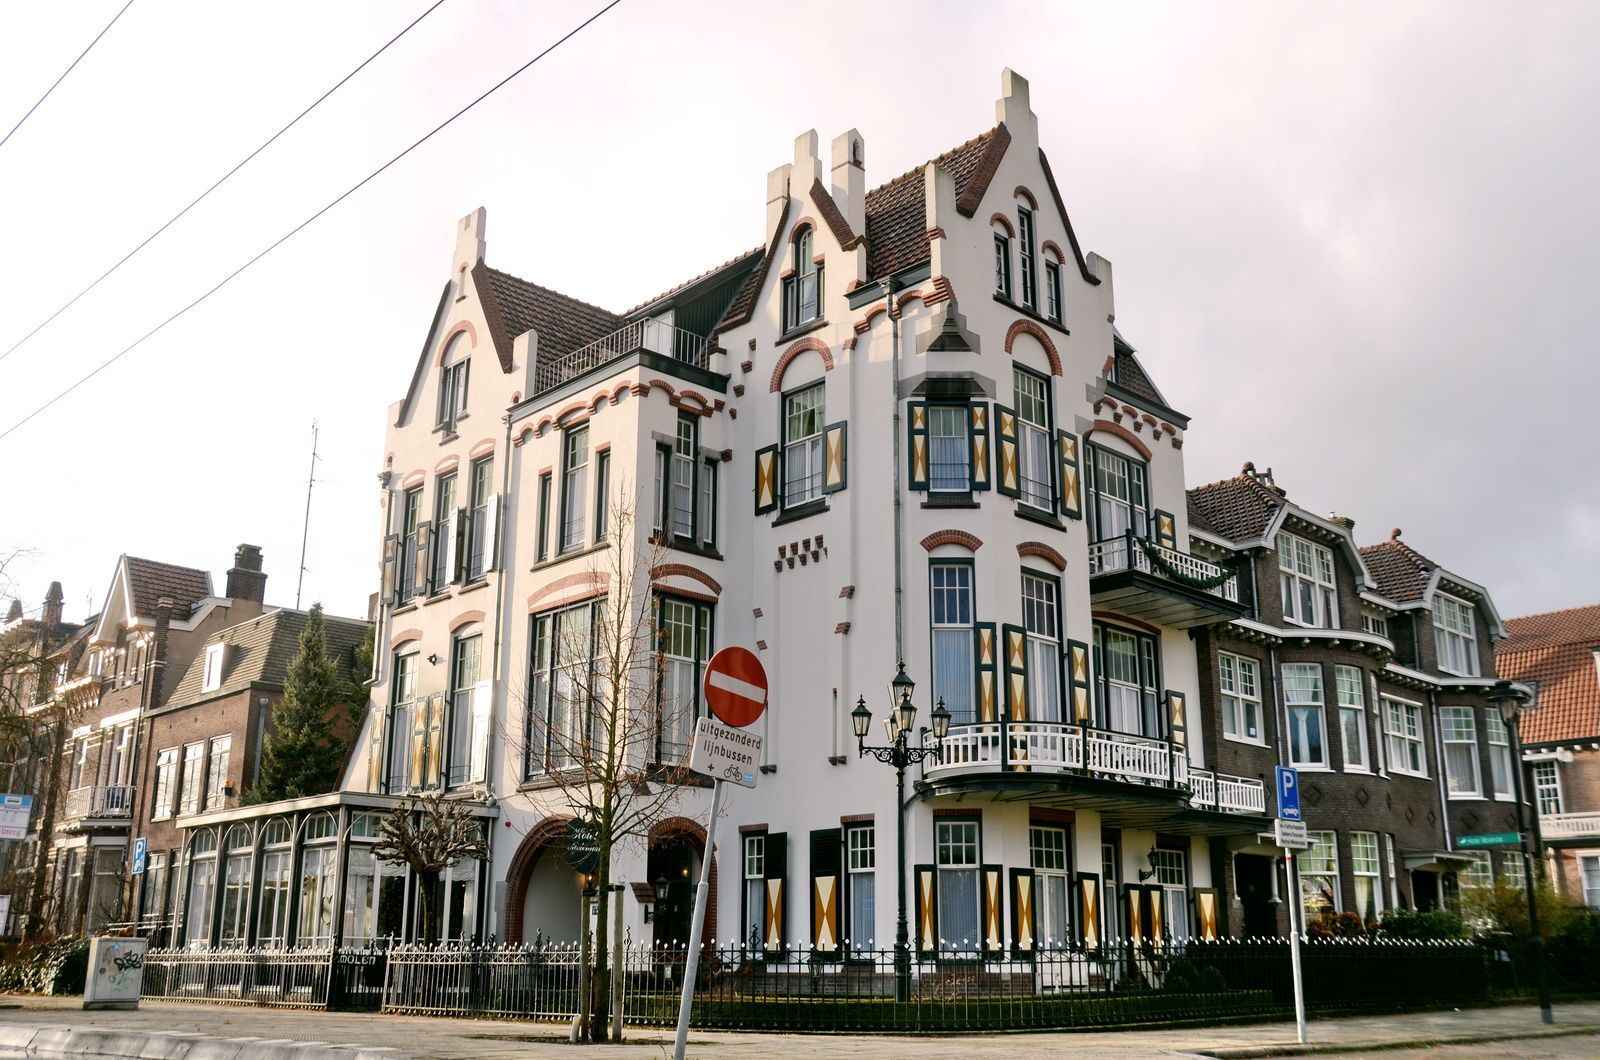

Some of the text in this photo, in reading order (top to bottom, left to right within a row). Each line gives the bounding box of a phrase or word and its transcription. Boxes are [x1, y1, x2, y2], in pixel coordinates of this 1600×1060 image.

[701, 722, 761, 749] uitgezonderd
[704, 740, 753, 765] lijnbussen
[1282, 771, 1294, 797] P
[135, 840, 143, 860] P
